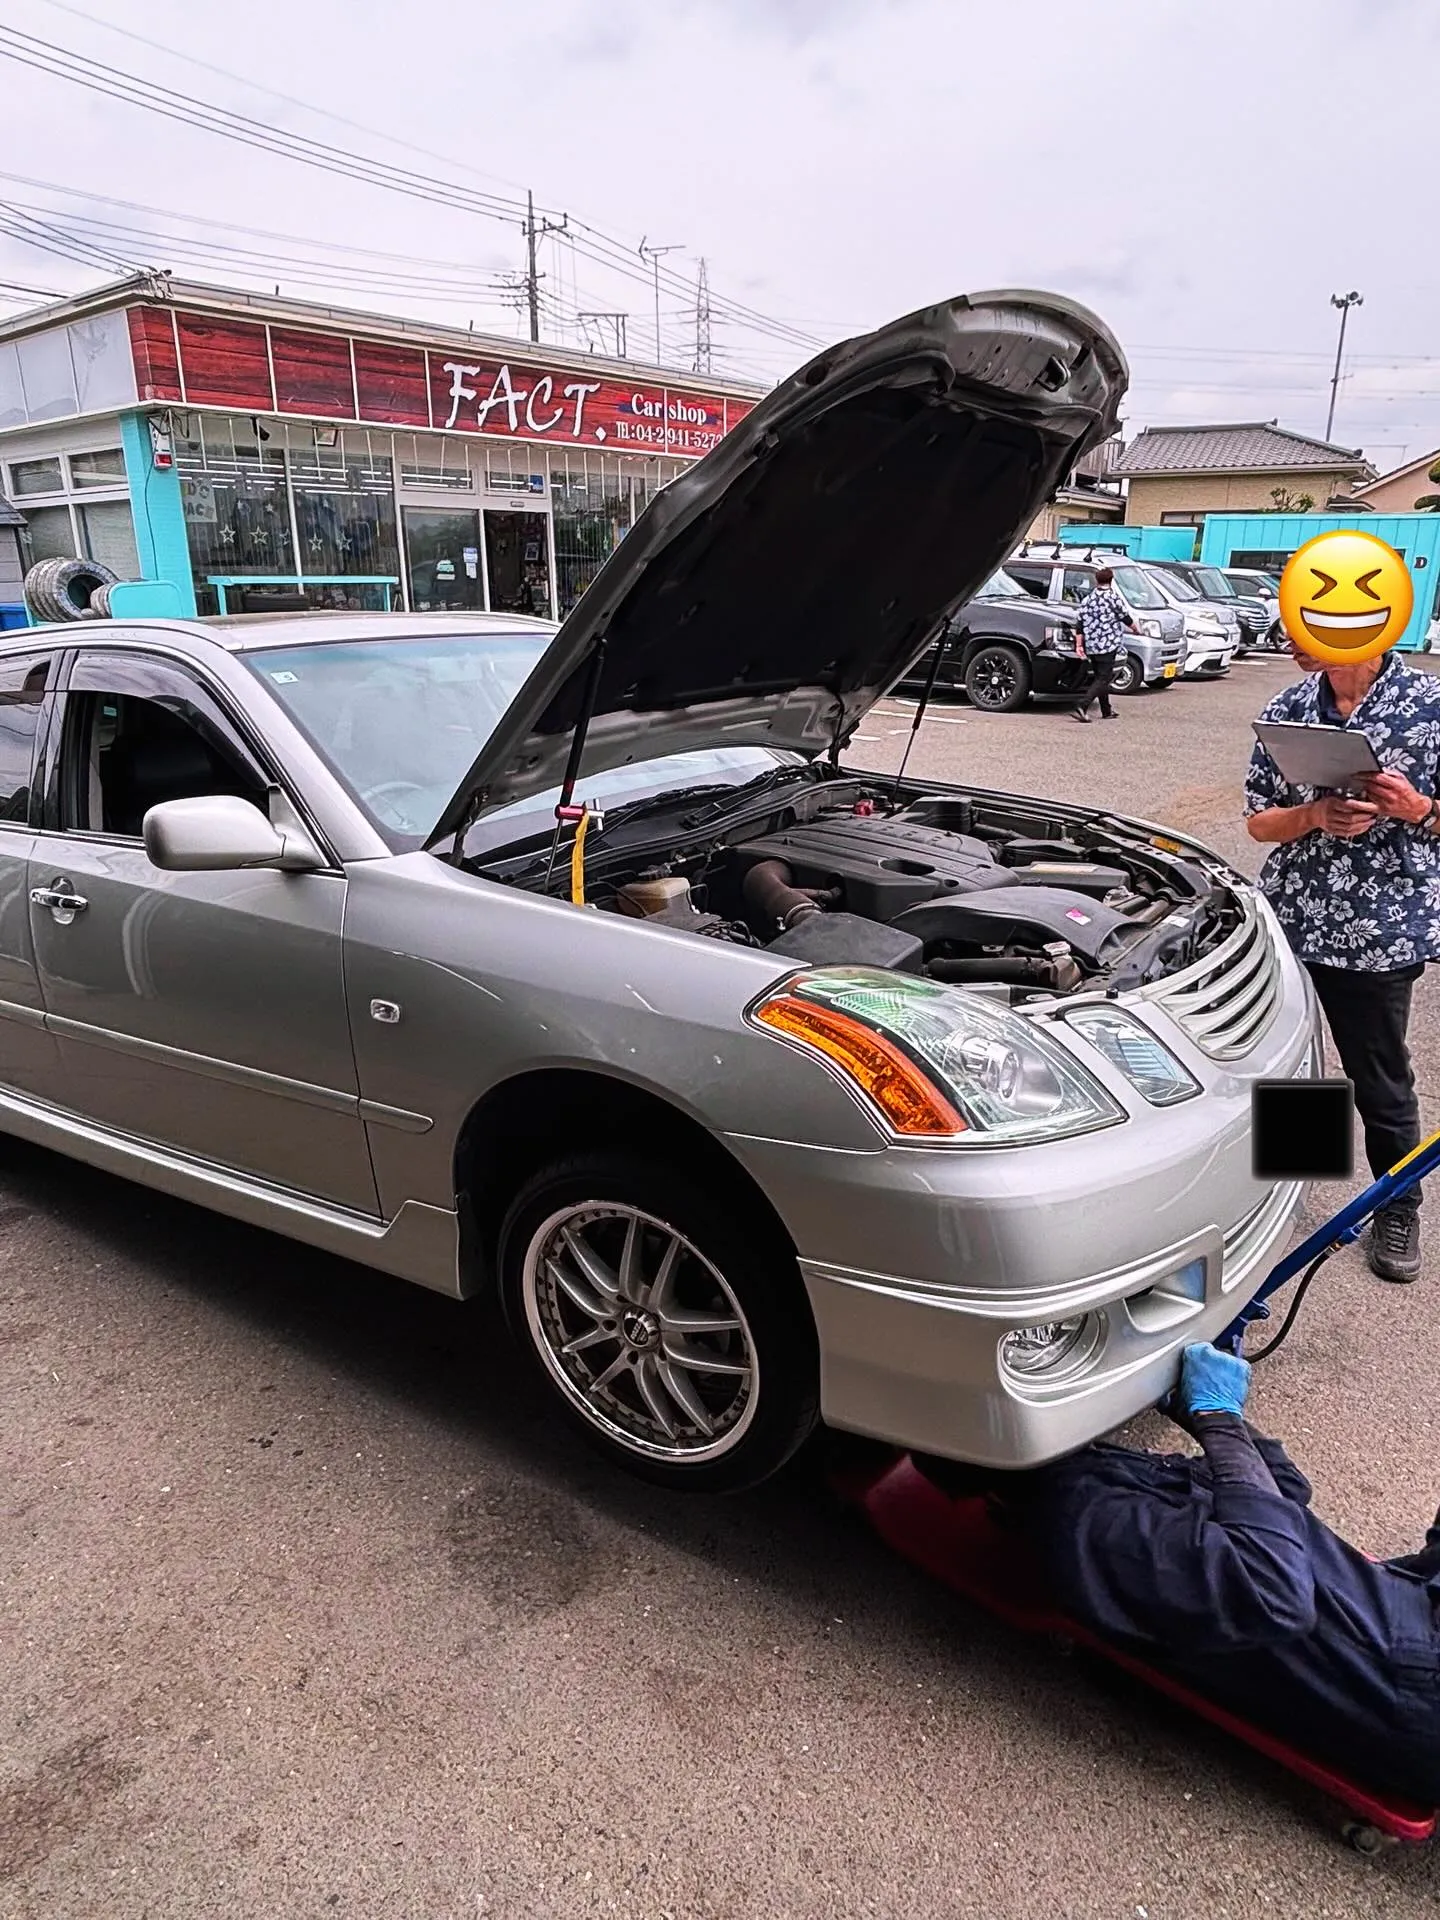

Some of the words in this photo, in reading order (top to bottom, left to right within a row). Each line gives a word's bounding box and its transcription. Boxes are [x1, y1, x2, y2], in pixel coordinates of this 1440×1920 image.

[442, 361, 607, 441] FACT.
[631, 393, 663, 418] Car
[668, 399, 707, 426] shop
